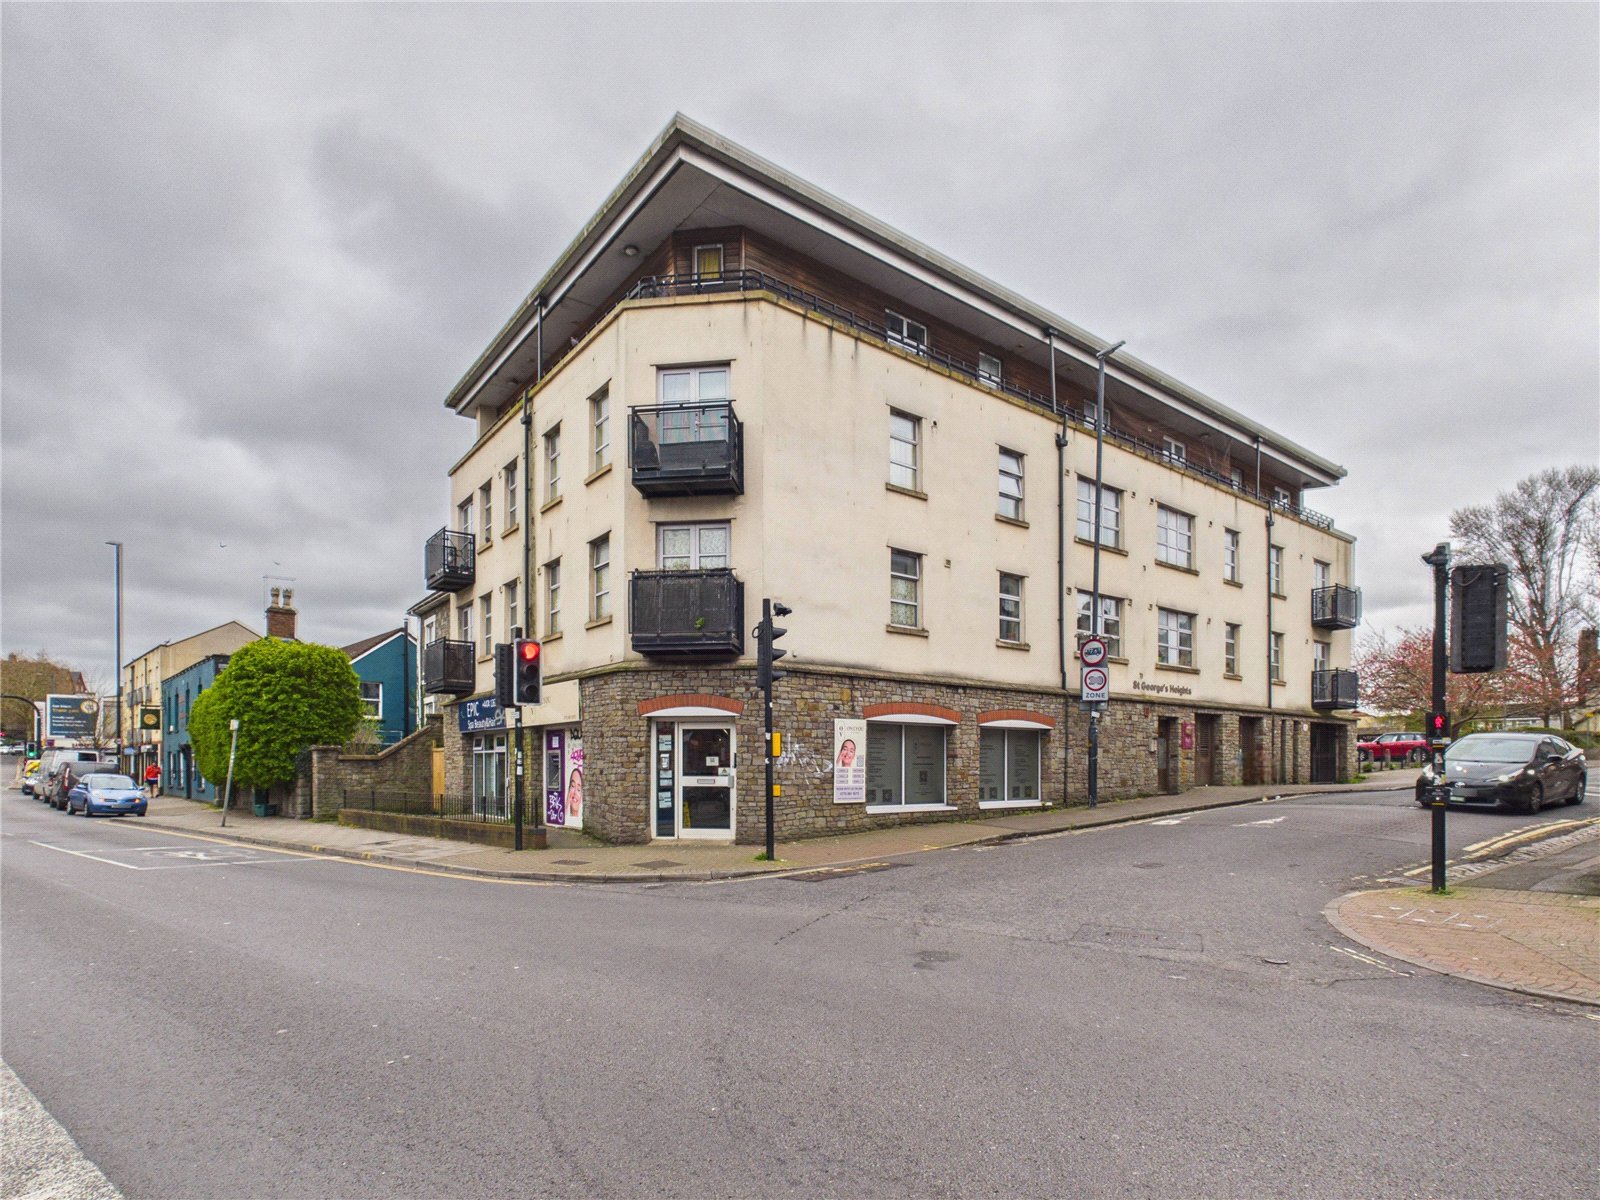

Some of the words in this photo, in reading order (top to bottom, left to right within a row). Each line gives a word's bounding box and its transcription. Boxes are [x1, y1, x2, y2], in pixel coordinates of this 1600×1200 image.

[1088, 676, 1104, 686] 20
[1133, 681, 1140, 690] St
[1141, 682, 1168, 693] George's
[1170, 685, 1192, 696] Heights
[467, 702, 479, 717] EPIC
